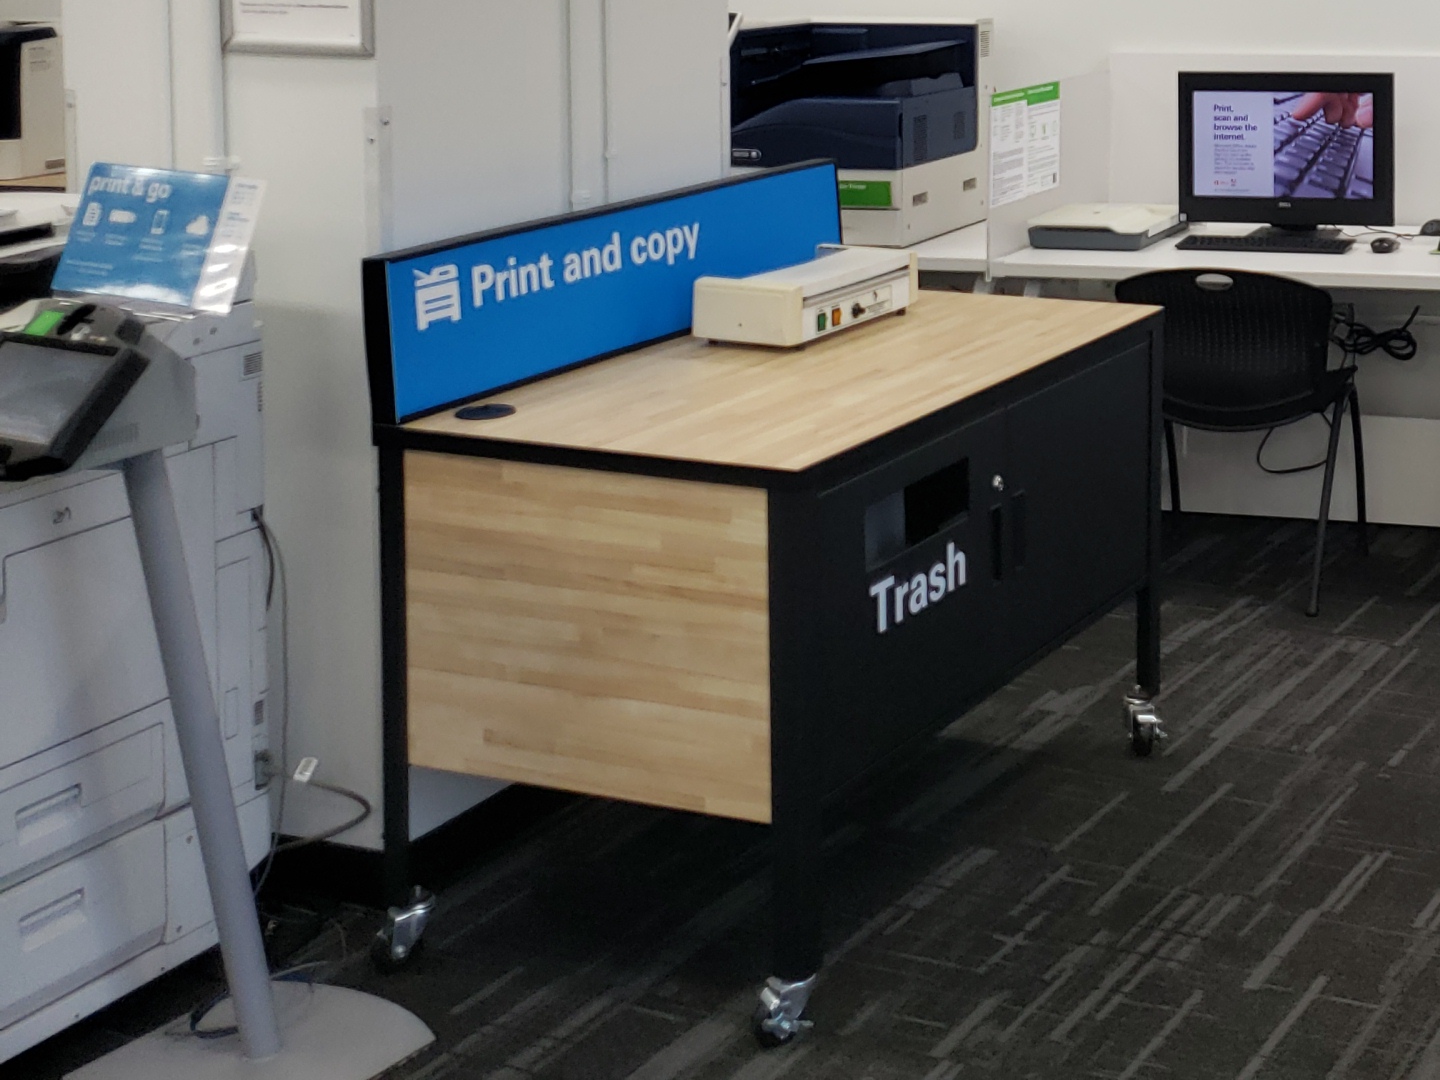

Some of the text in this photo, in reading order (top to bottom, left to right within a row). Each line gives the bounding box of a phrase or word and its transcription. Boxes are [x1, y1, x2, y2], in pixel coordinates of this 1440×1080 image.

[88, 176, 172, 203] print & go
[471, 222, 699, 308] Print and copy
[869, 542, 966, 633] Trash
